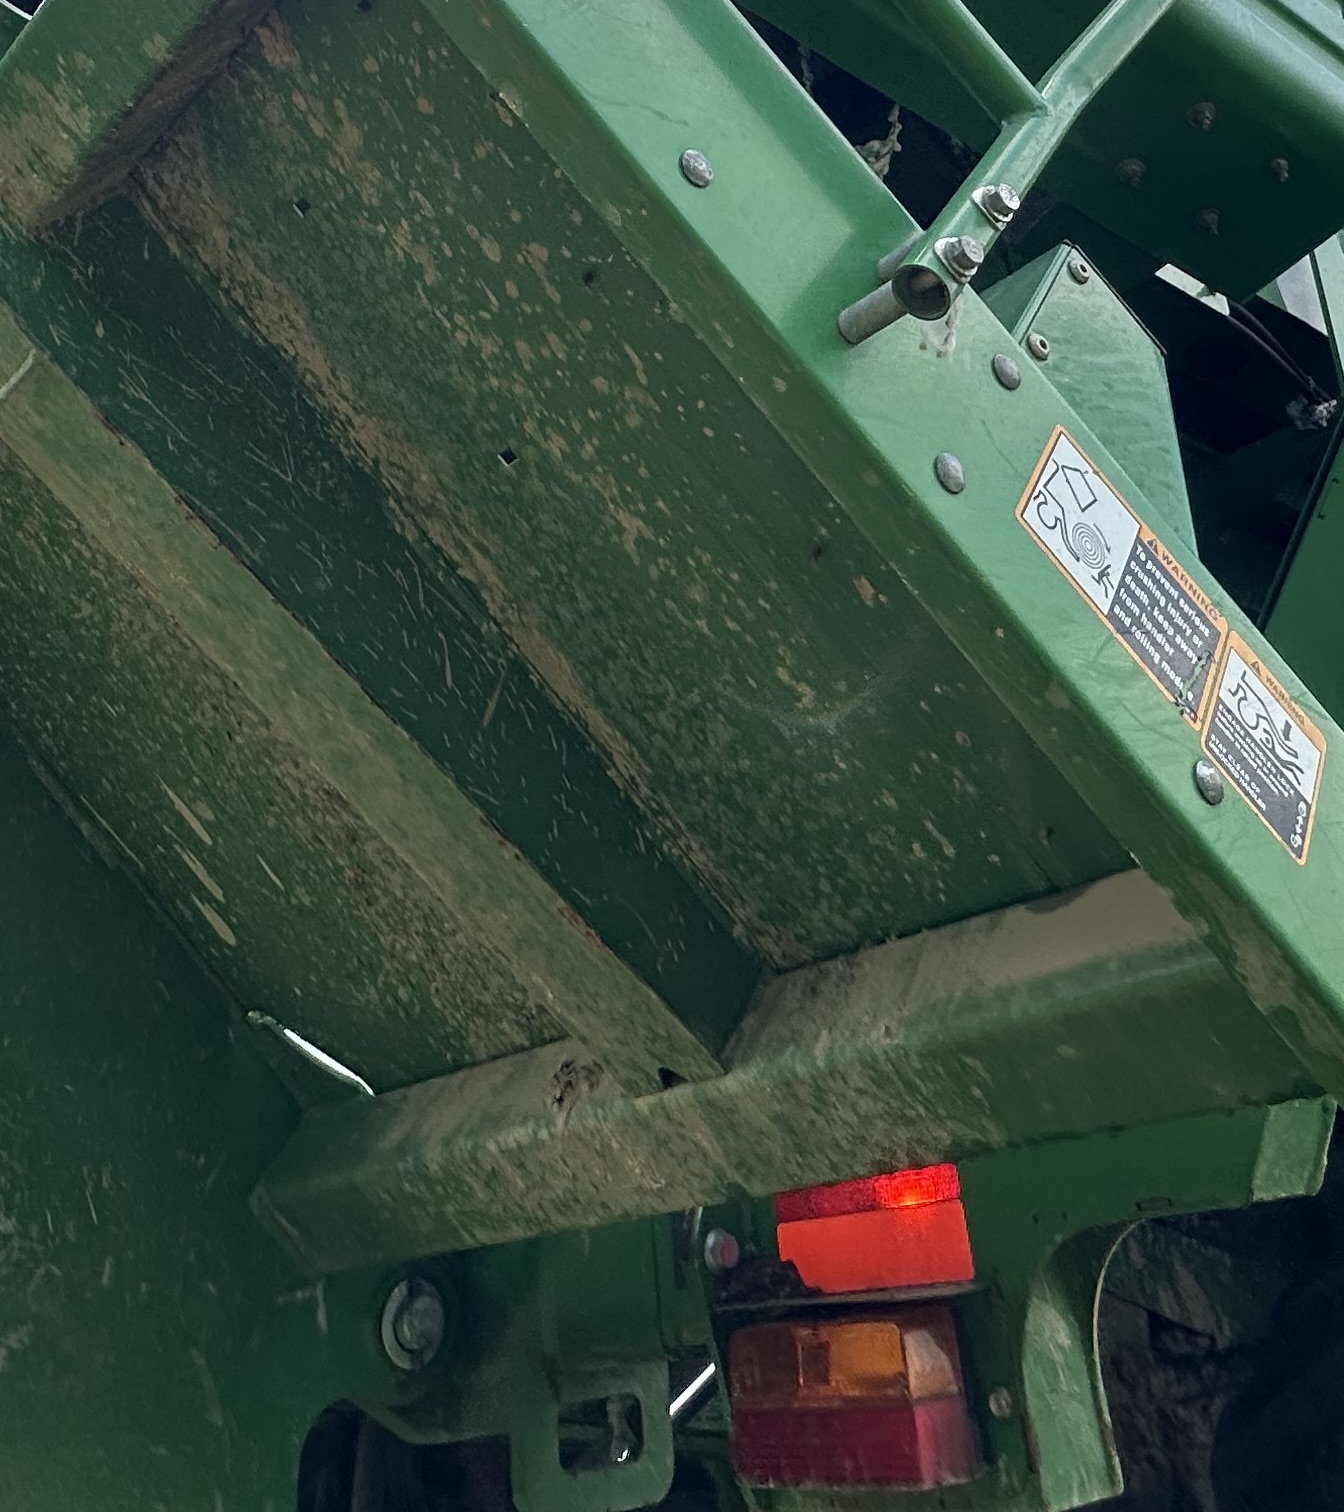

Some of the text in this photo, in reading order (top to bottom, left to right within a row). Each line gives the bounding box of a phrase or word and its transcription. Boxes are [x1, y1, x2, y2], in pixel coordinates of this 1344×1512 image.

[1124, 575, 1198, 664] death, keep away
[1130, 560, 1203, 648] crushing injury or
[1136, 544, 1210, 637] To prevent serious
[1162, 550, 1218, 621] WARNING
[1114, 604, 1132, 627] and
[1131, 625, 1160, 664] rolling
[1119, 588, 1175, 656] from handler
[1266, 674, 1305, 726] WARNING
[1211, 733, 1226, 754] STAY
[1227, 754, 1250, 781] CLEAR
[1250, 781, 1260, 793] OF
[1219, 704, 1295, 796] ENGAGE HANDLER LOCK
